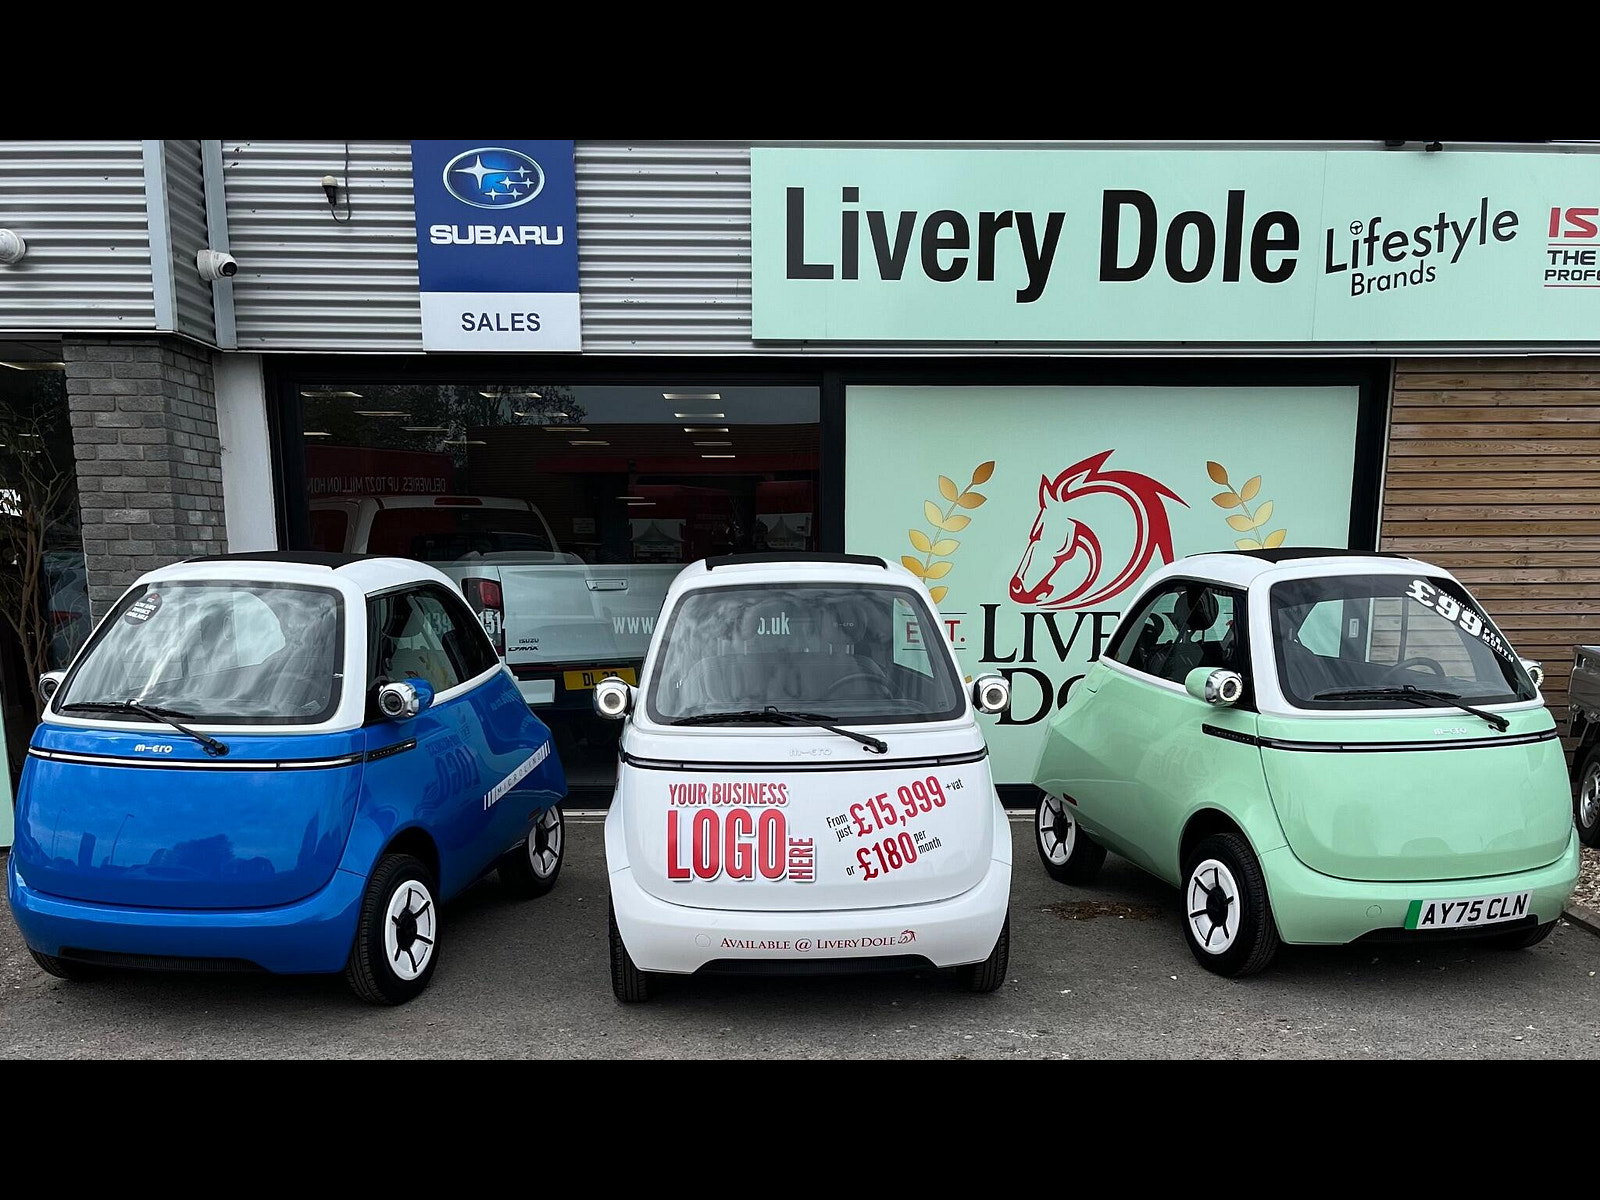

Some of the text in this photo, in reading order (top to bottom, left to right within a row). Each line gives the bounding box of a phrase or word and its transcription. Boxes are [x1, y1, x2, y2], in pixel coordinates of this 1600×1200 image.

[429, 224, 564, 246] SUBARU
[786, 186, 1300, 304] Livery Dole
[1325, 196, 1519, 274] Lifestyle
[1547, 250, 1597, 266] THE
[1351, 259, 1436, 297] Brands
[461, 312, 541, 332] SALES
[1405, 579, 1483, 637] £99
[1482, 635, 1514, 663] MONTH
[668, 782, 787, 805] YOUR BUSINESS
[849, 775, 947, 837] £15,999
[826, 813, 849, 829] From
[835, 824, 853, 842] just
[667, 808, 786, 879] LOGO
[913, 829, 927, 844] per
[918, 836, 942, 855] month
[788, 837, 814, 880] HERE
[846, 832, 918, 881] or £180
[1421, 893, 1528, 925] AY75 CLN
[794, 938, 813, 953] @
